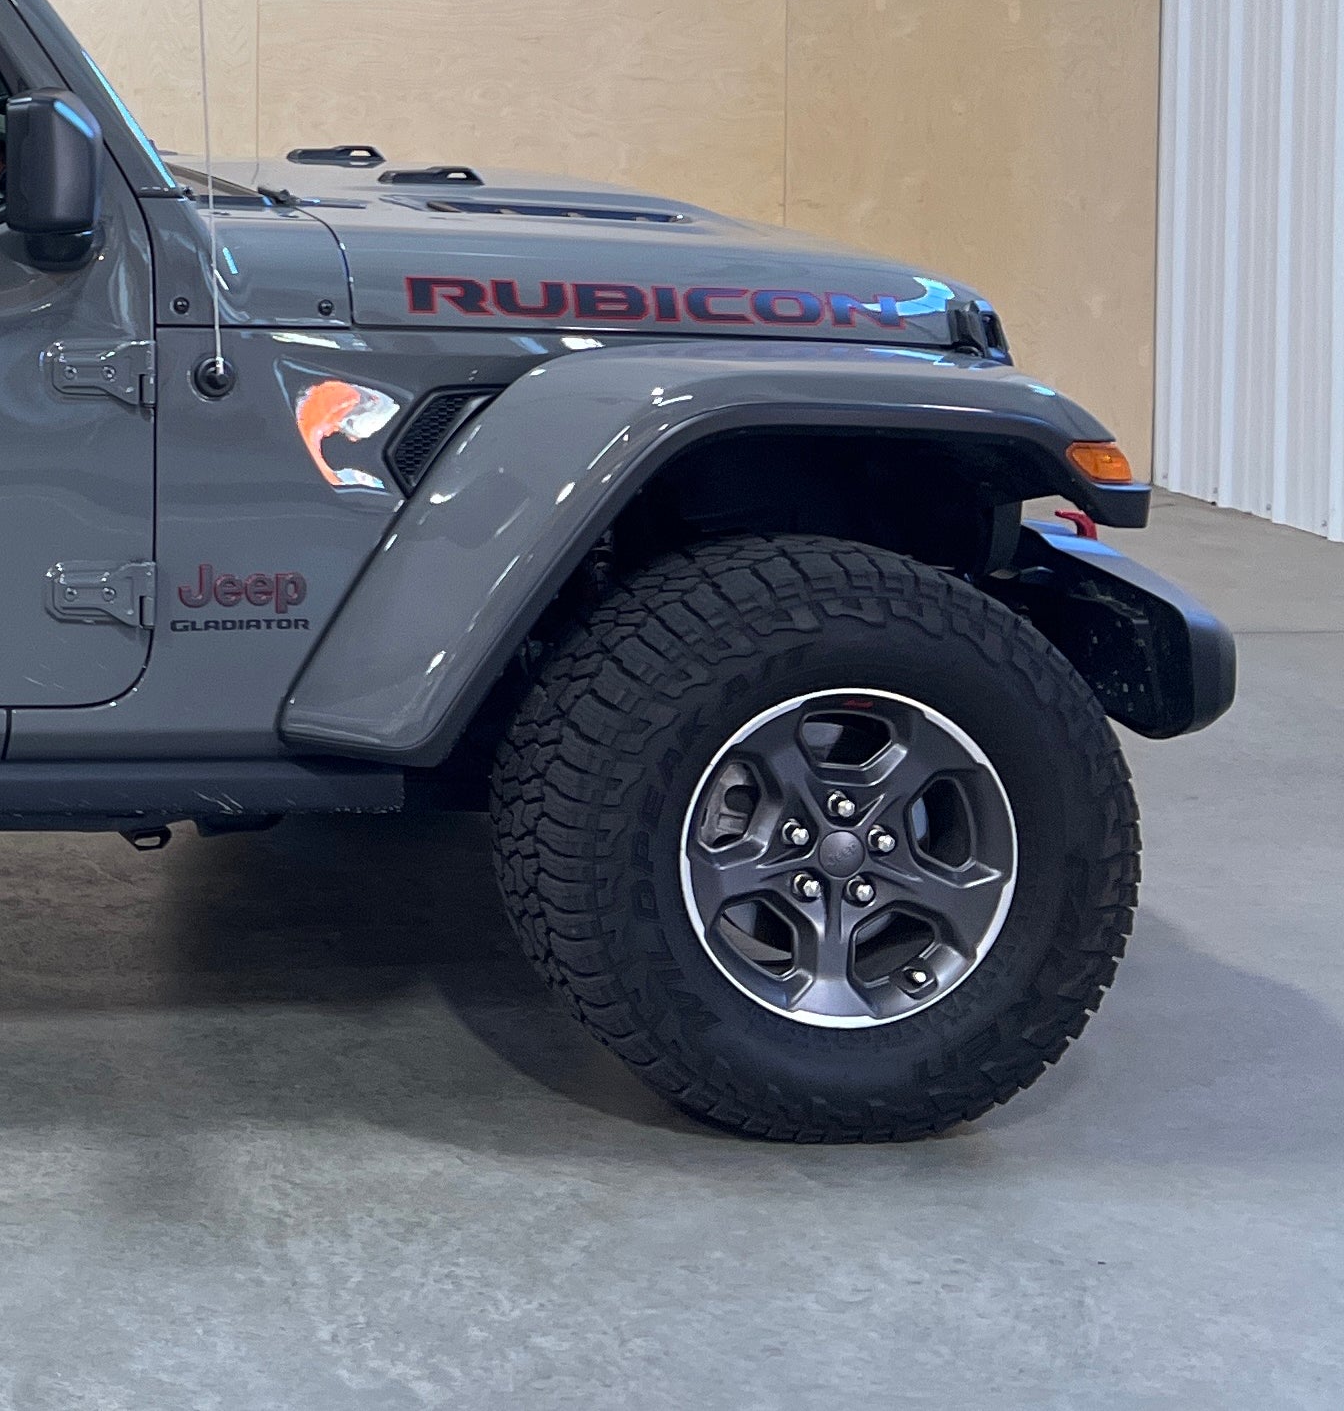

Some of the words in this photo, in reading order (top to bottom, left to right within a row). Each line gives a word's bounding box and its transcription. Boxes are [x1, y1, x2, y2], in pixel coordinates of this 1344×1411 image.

[404, 275, 909, 331] RUBICON
[178, 563, 308, 614] Jeep
[170, 618, 311, 632] GLADIATOR
